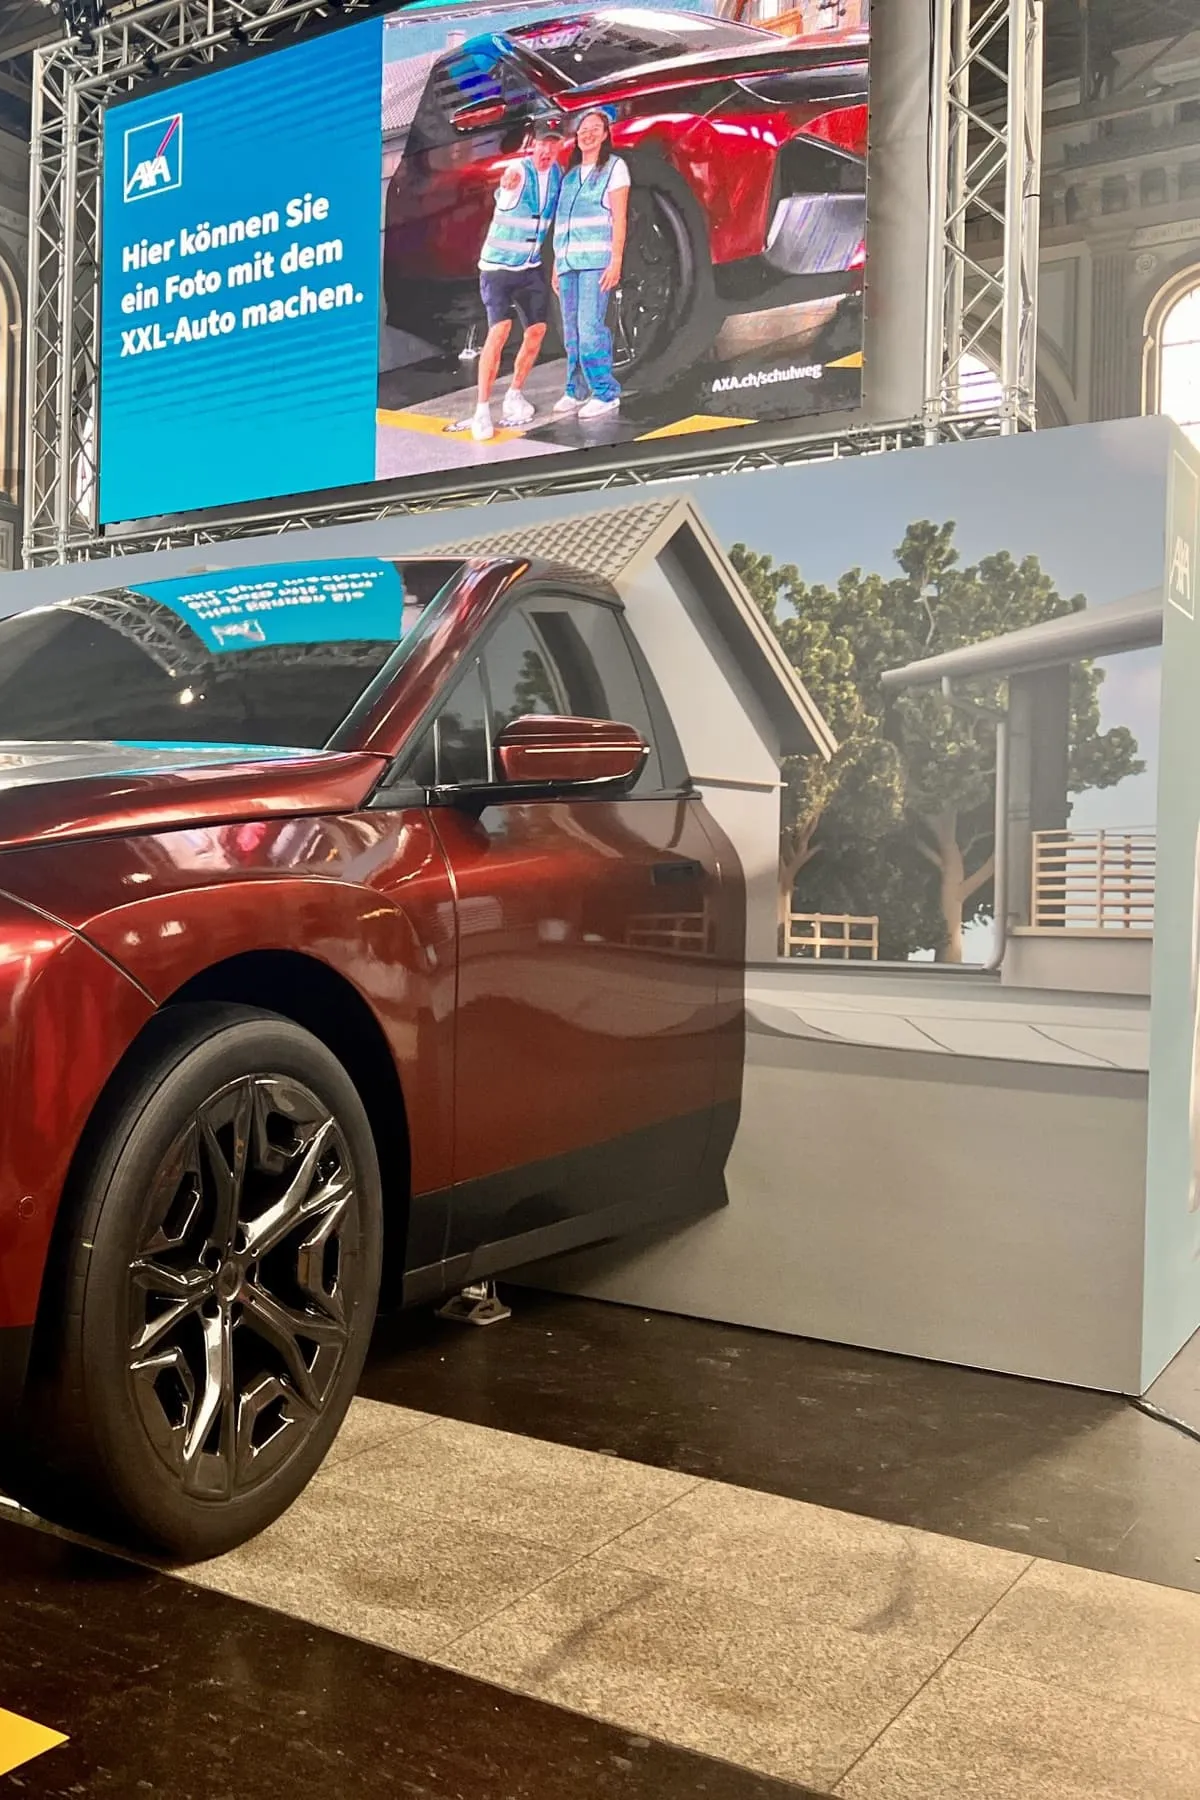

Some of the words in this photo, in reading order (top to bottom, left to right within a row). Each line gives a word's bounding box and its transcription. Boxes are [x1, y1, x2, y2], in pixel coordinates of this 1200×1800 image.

[126, 155, 171, 195] AXA
[122, 239, 175, 272] Hier
[180, 221, 279, 256] können
[286, 193, 329, 228] Sie
[121, 282, 159, 313] ein
[165, 269, 221, 303] Foto
[228, 251, 274, 288] mit
[280, 238, 343, 274] dem
[120, 309, 236, 357] XXL-Auto
[242, 282, 363, 329] machen.
[712, 363, 822, 392] AXA.ch/schulweg
[1169, 535, 1190, 600] AXA
